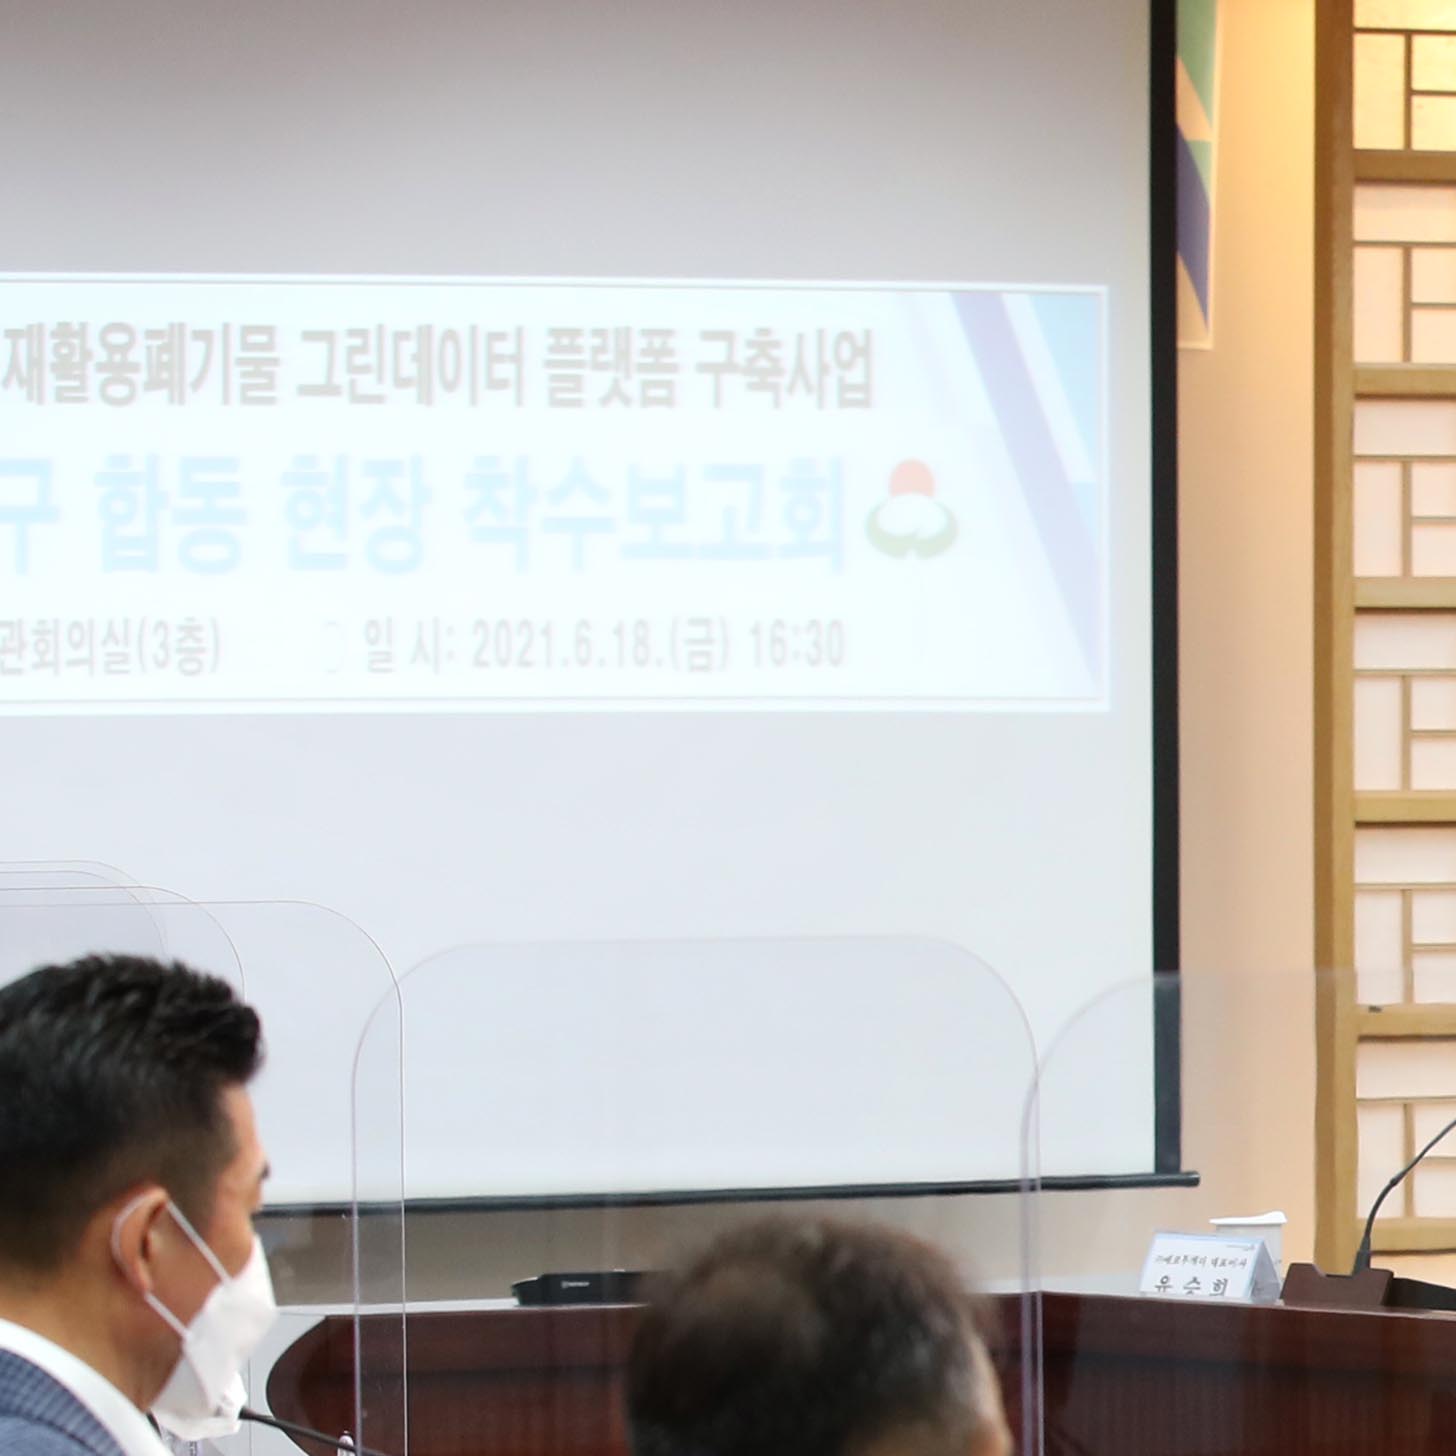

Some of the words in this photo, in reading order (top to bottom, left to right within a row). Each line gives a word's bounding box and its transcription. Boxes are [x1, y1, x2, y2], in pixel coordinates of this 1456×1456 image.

[1, 322, 281, 406] 재활용폐기물
[297, 323, 526, 408] 그린데이터
[543, 326, 680, 409] 플랫폼
[695, 326, 876, 410] 구축사업
[94, 452, 249, 576] 합동
[281, 453, 433, 575] 현장
[463, 454, 846, 576] 착수보고회
[472, 616, 731, 676] 2021.6.18.(금)
[750, 617, 846, 670] 16:30
